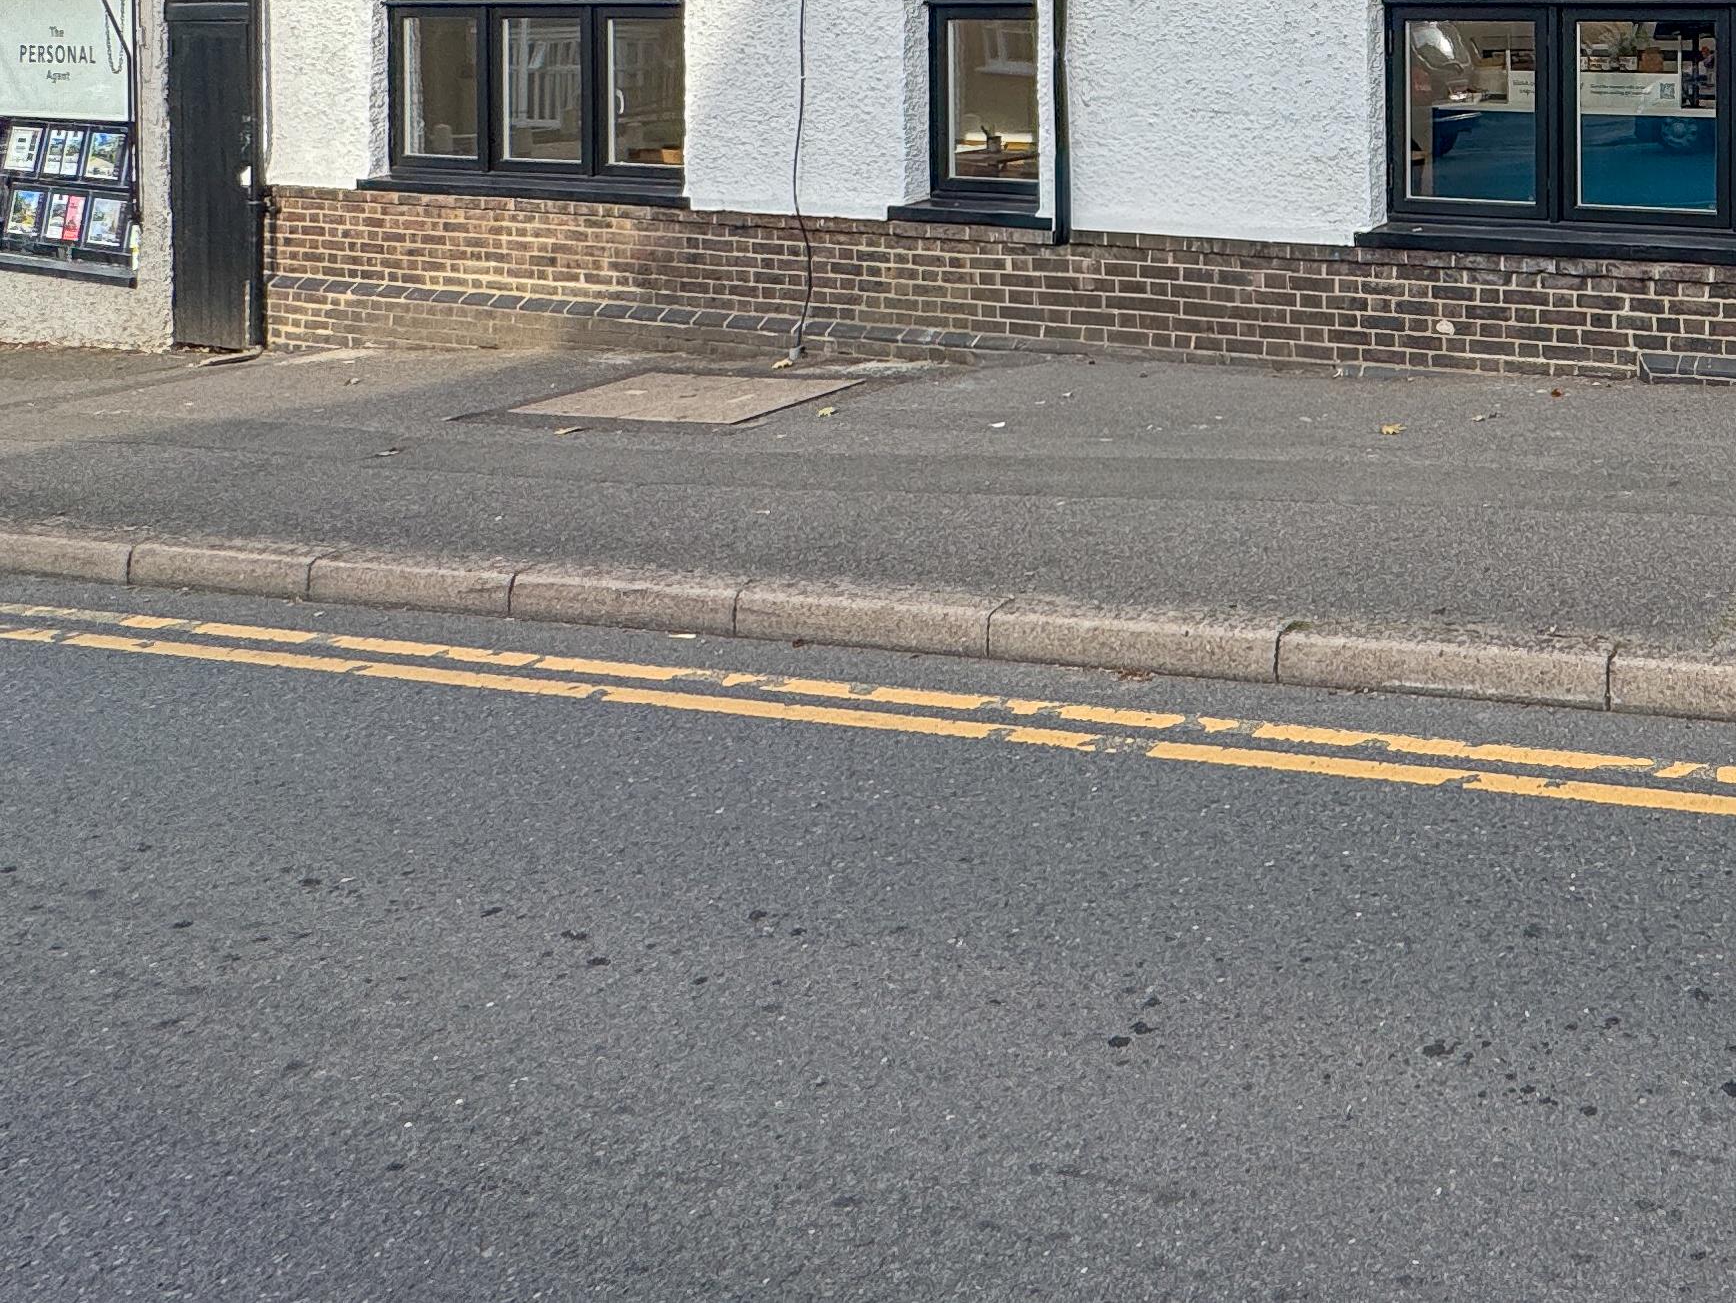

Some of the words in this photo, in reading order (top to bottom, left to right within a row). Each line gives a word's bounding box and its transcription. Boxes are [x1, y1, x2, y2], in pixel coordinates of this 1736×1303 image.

[48, 25, 65, 38] The
[19, 44, 97, 65] PERSONAL
[46, 69, 70, 84] Agent
